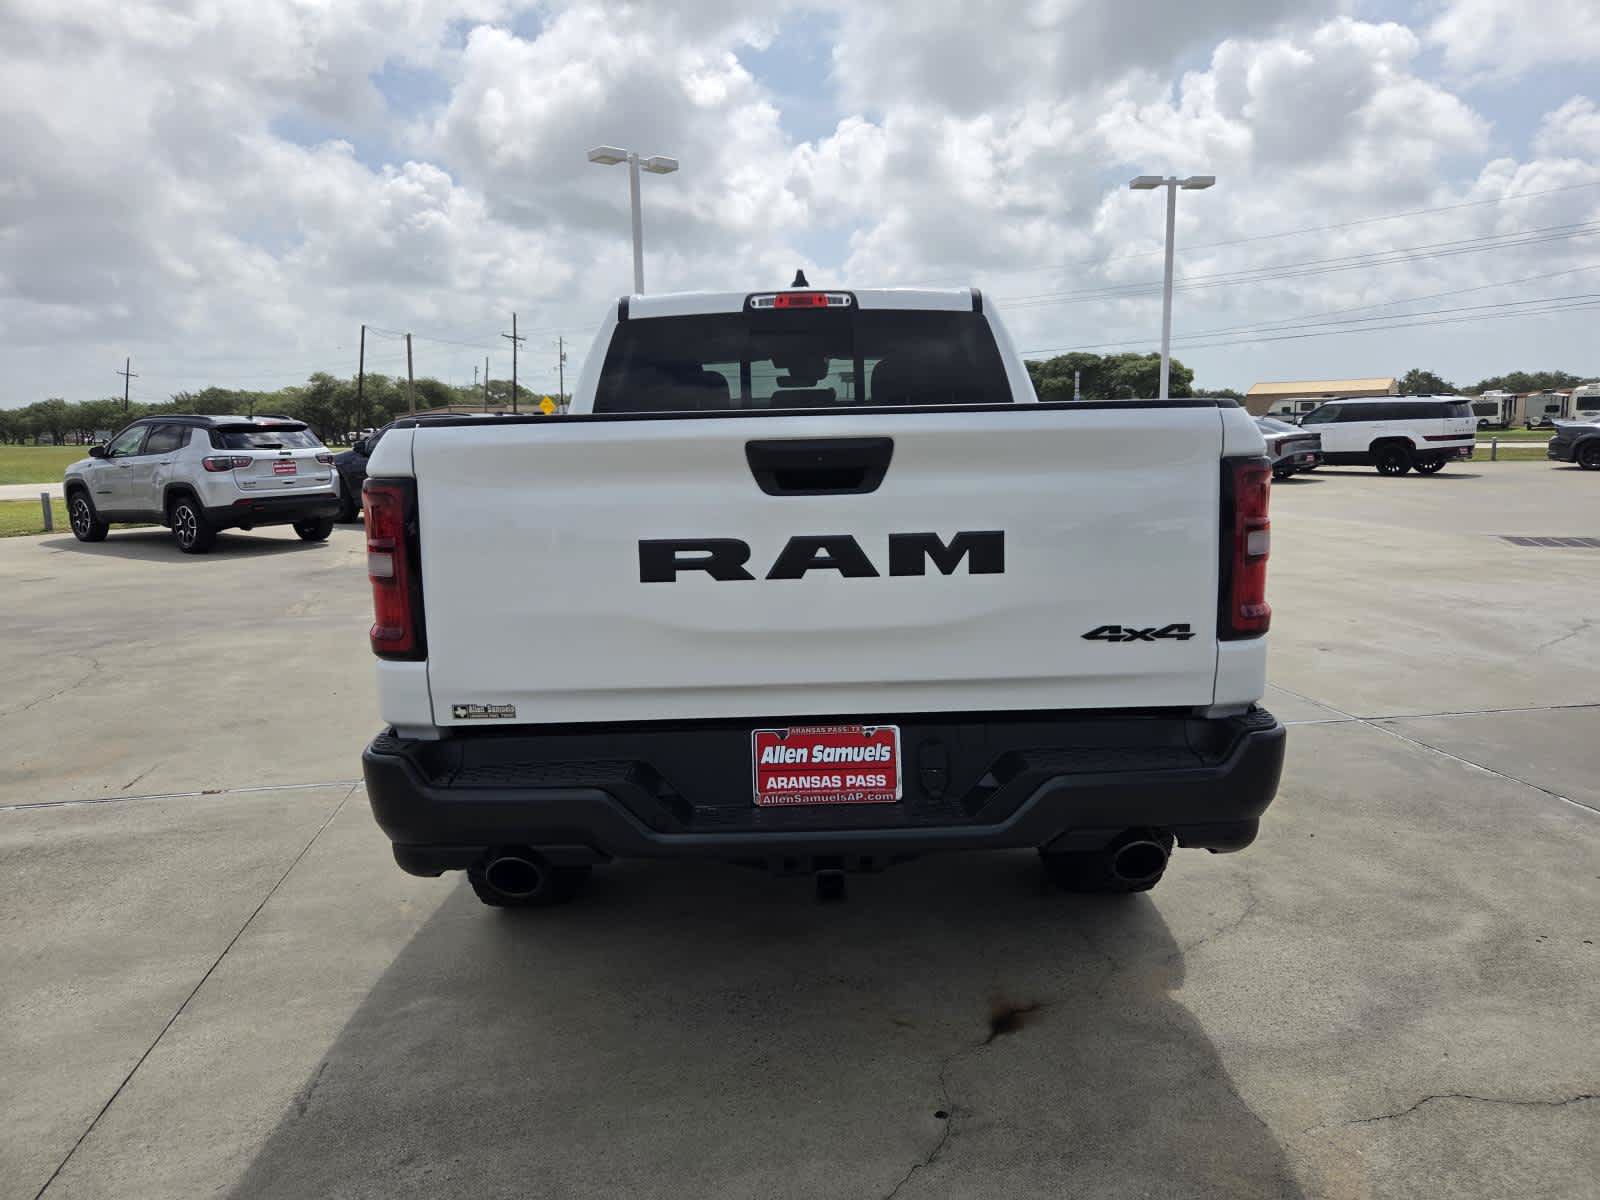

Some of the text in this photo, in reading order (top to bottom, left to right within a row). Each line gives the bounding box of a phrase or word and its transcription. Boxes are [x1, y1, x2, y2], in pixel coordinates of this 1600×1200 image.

[638, 530, 1005, 583] RAM
[1081, 623, 1196, 642] 4x4
[761, 743, 891, 764] Allen Samuels
[766, 774, 887, 789] ARANSAS PASS
[763, 792, 894, 804] AllenSamuelsAP.com
